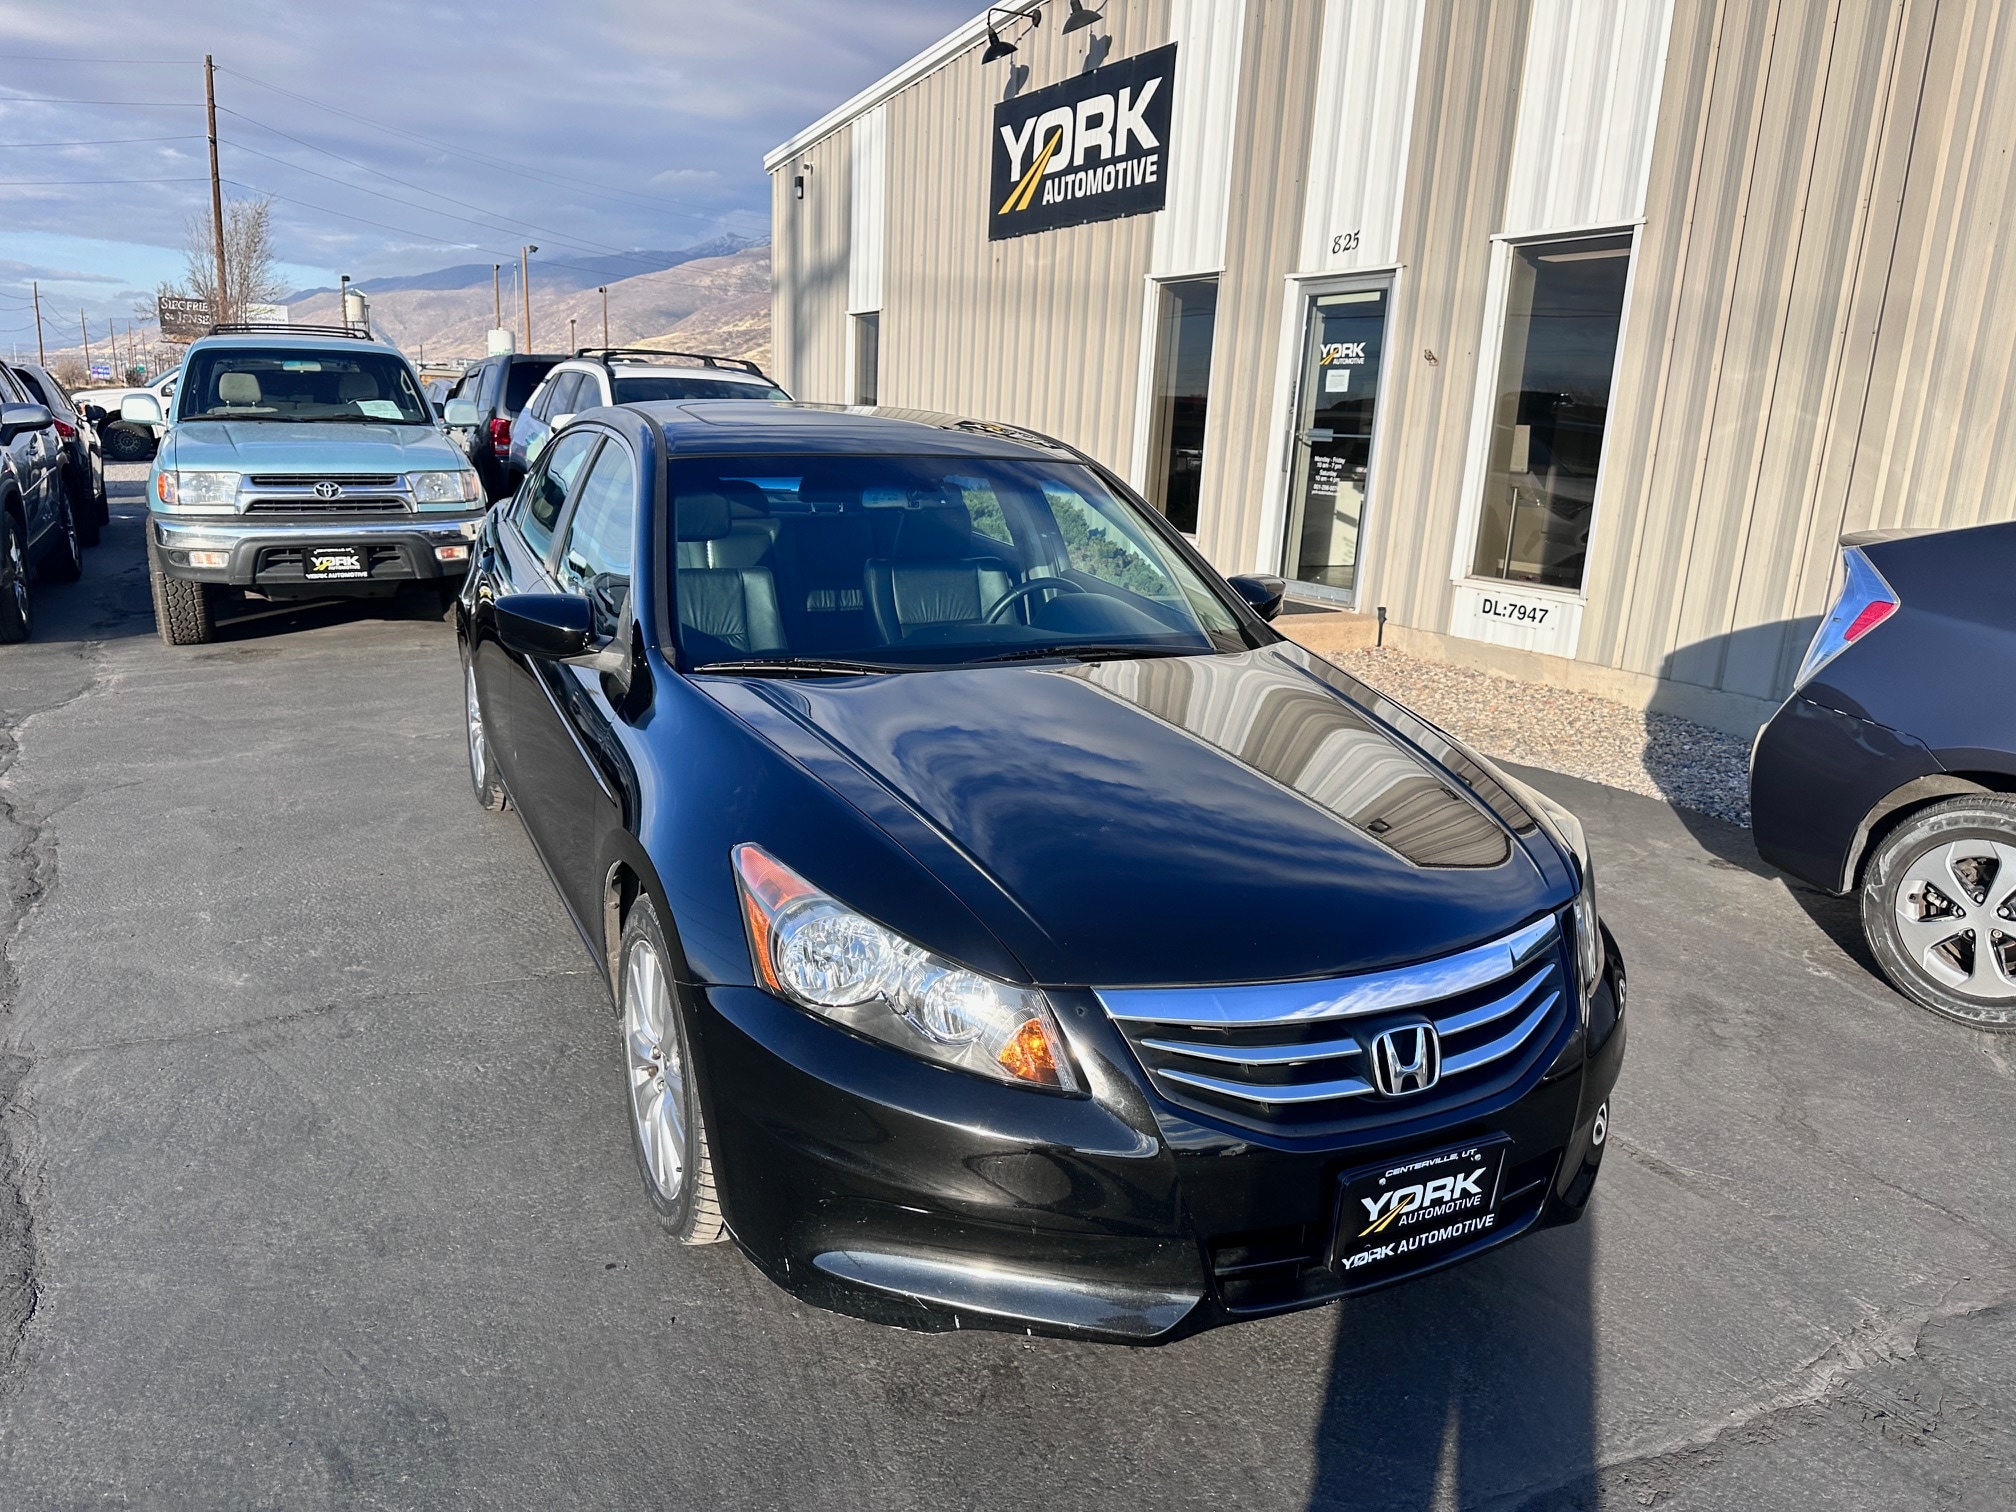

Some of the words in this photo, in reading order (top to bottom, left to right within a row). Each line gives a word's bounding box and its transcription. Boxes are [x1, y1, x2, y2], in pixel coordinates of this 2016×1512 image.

[1000, 77, 1162, 183] YORK
[1042, 154, 1158, 205] AUTOMOTIVE
[1332, 230, 1360, 254] 825
[1320, 342, 1366, 358] YORK
[1319, 469, 1337, 477] Saturday
[1333, 456, 1346, 464] Friday
[310, 556, 360, 567] YORK
[1482, 598, 1549, 624] DL:7947
[1385, 1153, 1460, 1178] CENTERVILLE,
[1462, 1148, 1478, 1159] UT
[1361, 1166, 1486, 1222] YORK
[1398, 1194, 1482, 1227] AUTOMOTIVE
[1341, 1242, 1395, 1270] YORK
[1397, 1213, 1496, 1254] AUTOMOTIVE
